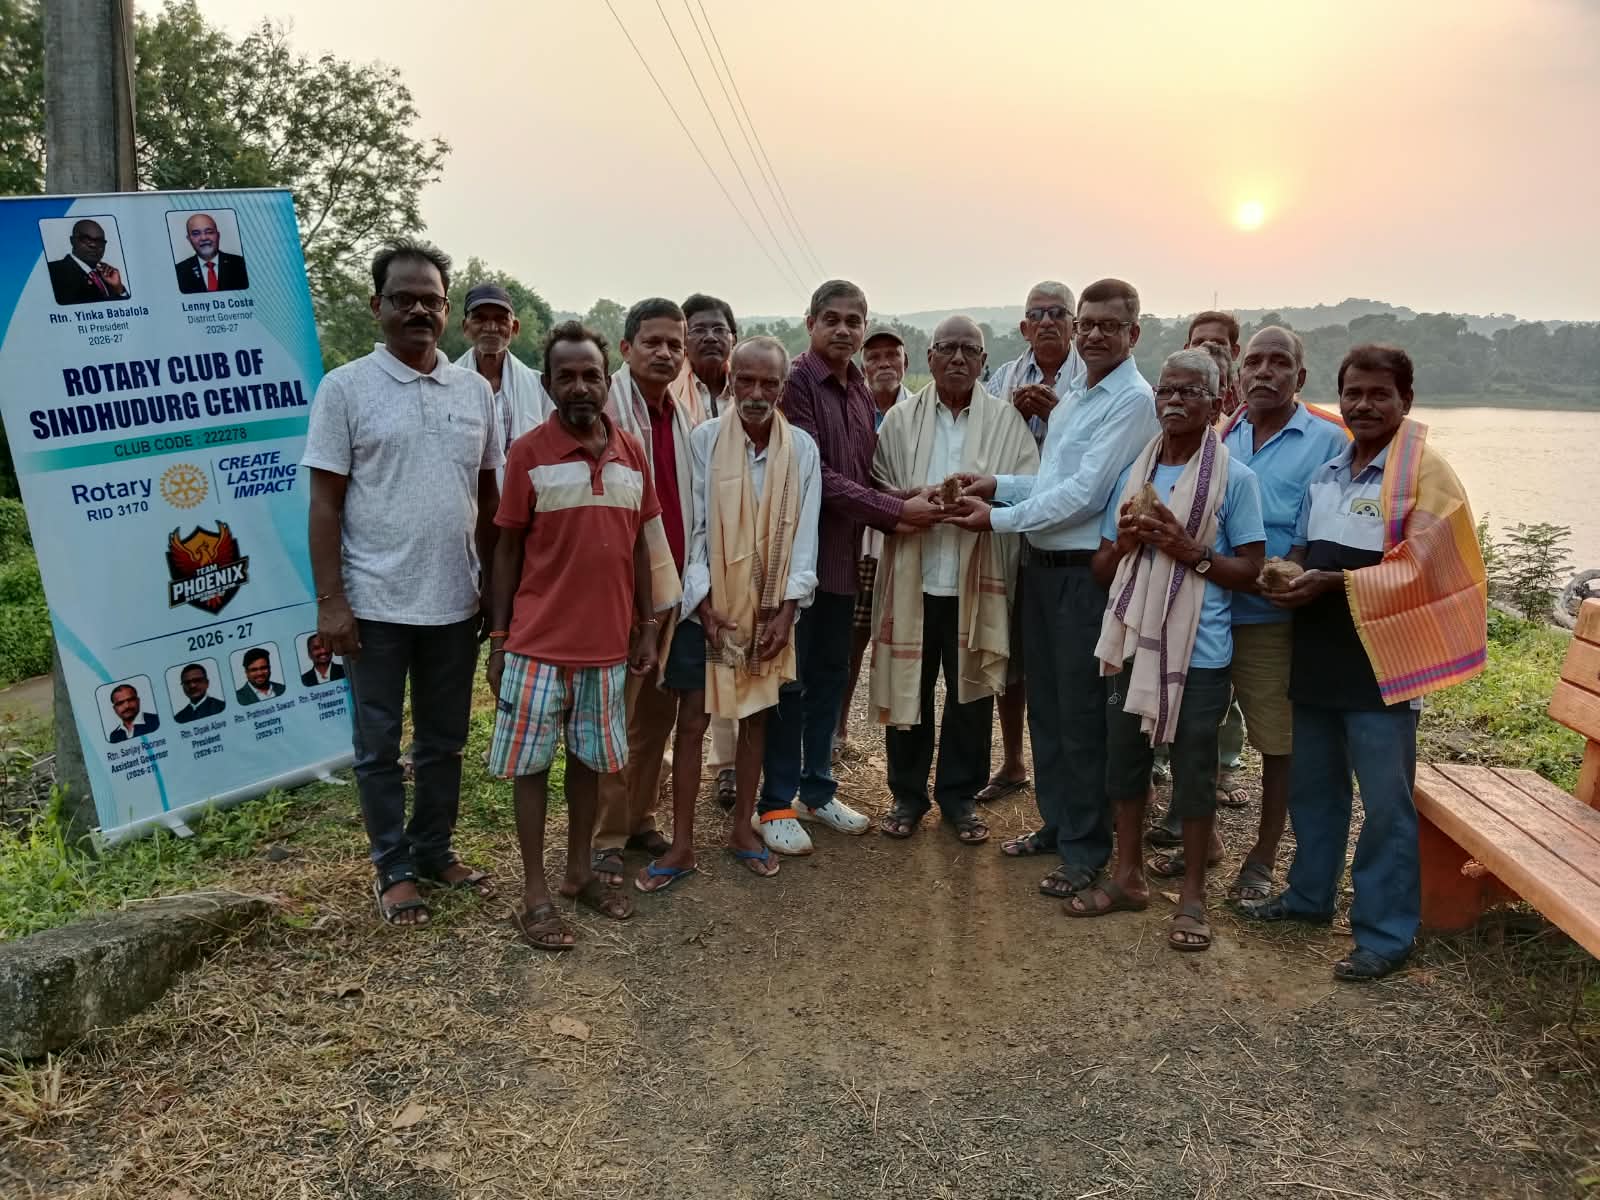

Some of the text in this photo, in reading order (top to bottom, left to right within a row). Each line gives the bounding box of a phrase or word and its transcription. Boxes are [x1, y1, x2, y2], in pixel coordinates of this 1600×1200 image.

[49, 306, 149, 324] Rtn. Yinka Babalola
[182, 298, 254, 312] Lenny Da Costa
[78, 322, 129, 335] RI President
[187, 312, 253, 324] District Governor
[206, 323, 239, 335] 2026-27
[88, 334, 123, 346] 2026-27
[62, 349, 264, 397] ROTARY CLUB OF
[29, 380, 308, 440] SINDHUDURG CENTRAL
[114, 440, 151, 457] CLUB
[154, 434, 193, 451] CODE
[204, 427, 248, 444] 222278
[218, 451, 281, 471] CREATE
[227, 463, 297, 486] LASTING
[71, 478, 152, 505] Rotary
[234, 478, 295, 499] IMPACT
[87, 500, 149, 521] RID 3170
[196, 563, 218, 576] TEAM
[172, 563, 245, 601] PHOENIX
[187, 630, 224, 651] 2026
[237, 622, 253, 639] 27
[192, 734, 222, 748] President
[111, 750, 168, 774] Assistant Governor
